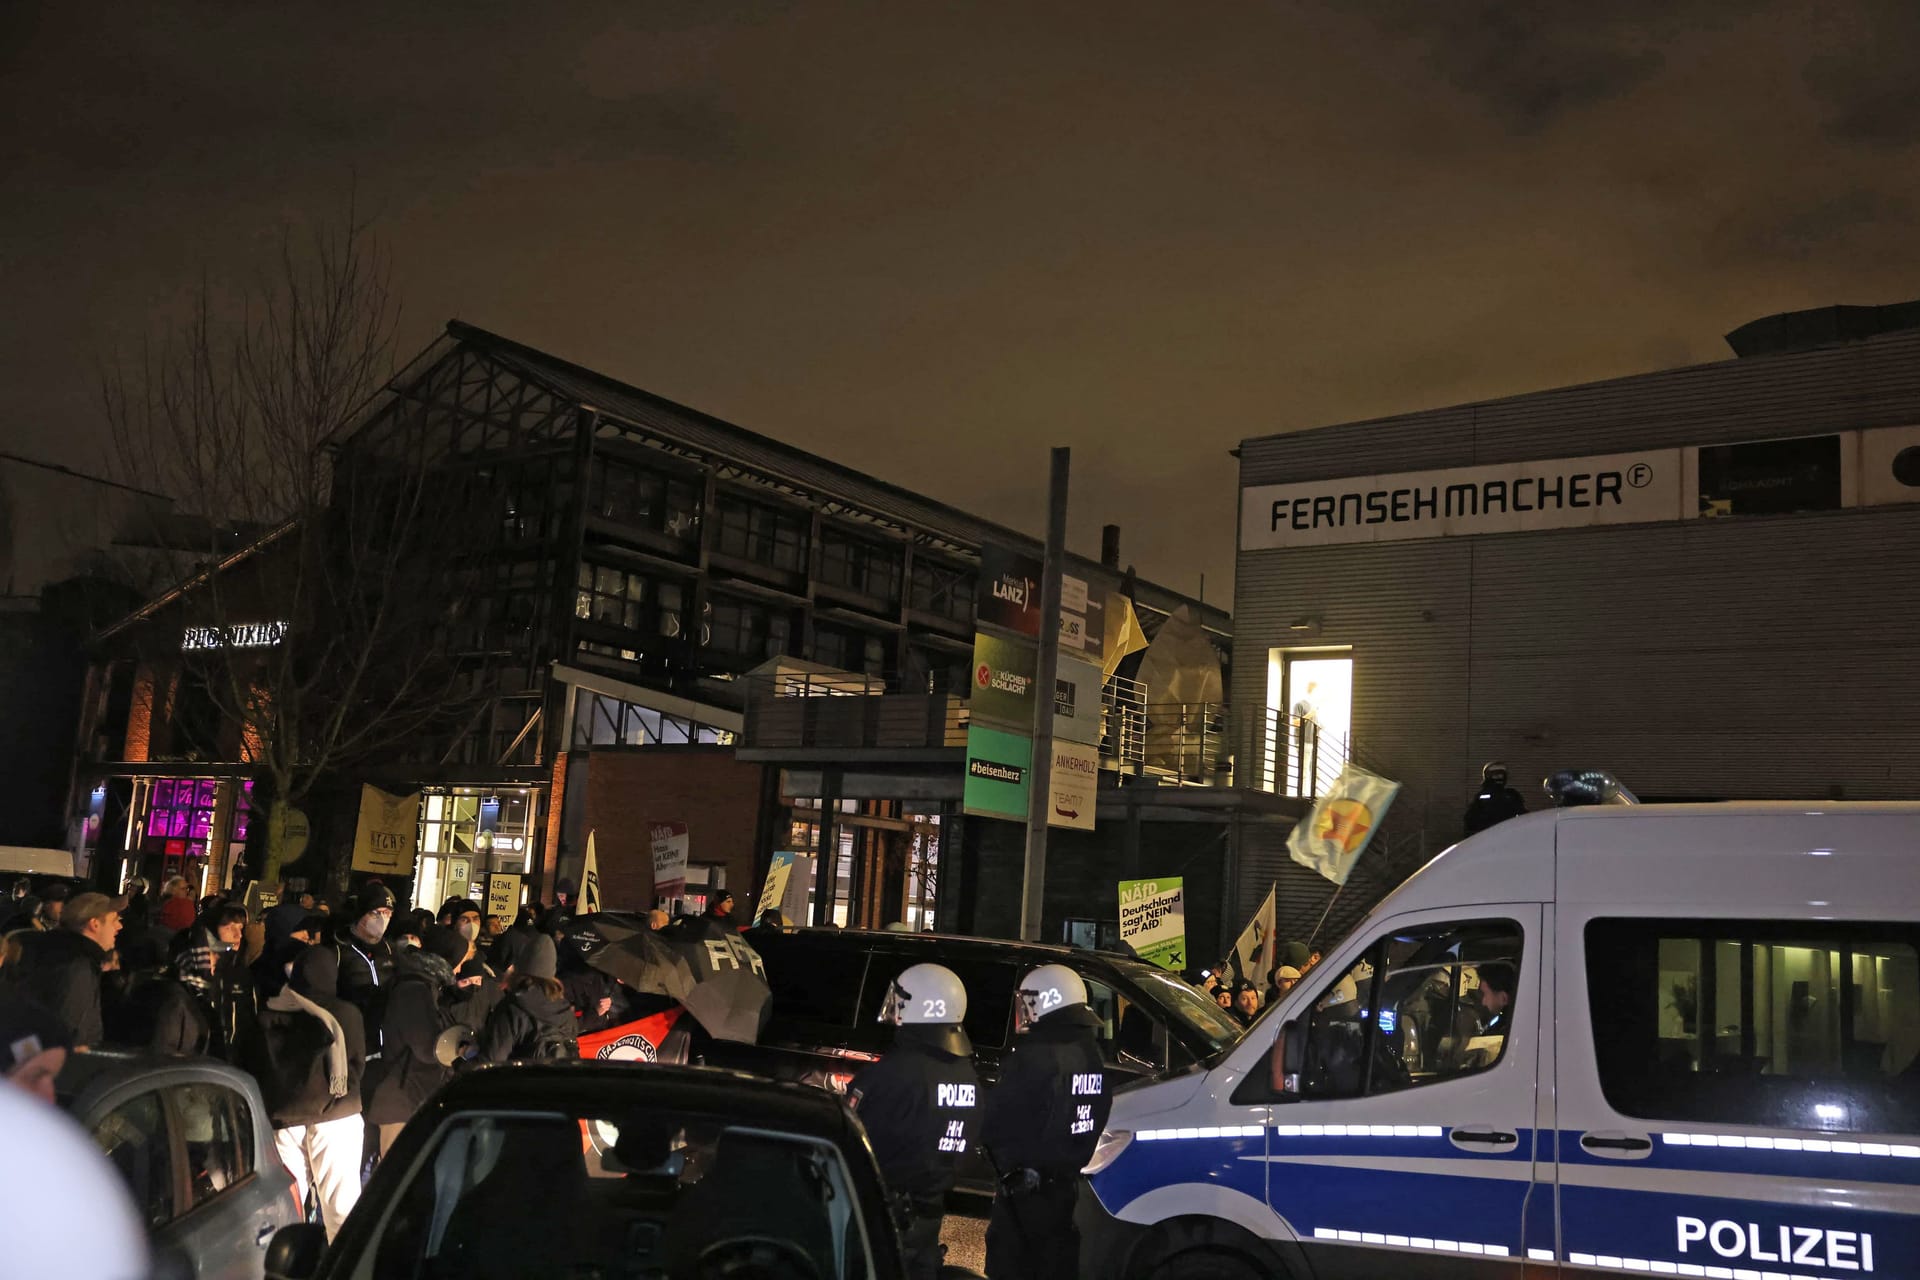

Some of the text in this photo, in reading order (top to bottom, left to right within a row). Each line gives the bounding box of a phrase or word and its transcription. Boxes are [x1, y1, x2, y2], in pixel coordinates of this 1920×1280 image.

[1271, 471, 1622, 531] FERNSEHMACHER
[991, 678, 1025, 696] SCHLACHT
[971, 761, 1020, 781] #beisenherz
[1056, 755, 1096, 774] ANKERHOLZ
[455, 867, 464, 878] 16
[1121, 882, 1158, 904] NÄfD
[1122, 892, 1180, 918] Deutschland
[1122, 905, 1172, 928] sagt NEIN
[1122, 926, 1139, 938] zur
[1039, 988, 1062, 1009] 23
[923, 999, 947, 1018] 23
[1076, 1104, 1092, 1119] HH
[945, 1120, 964, 1138] HH
[1677, 1216, 1874, 1272] POLIZEI
